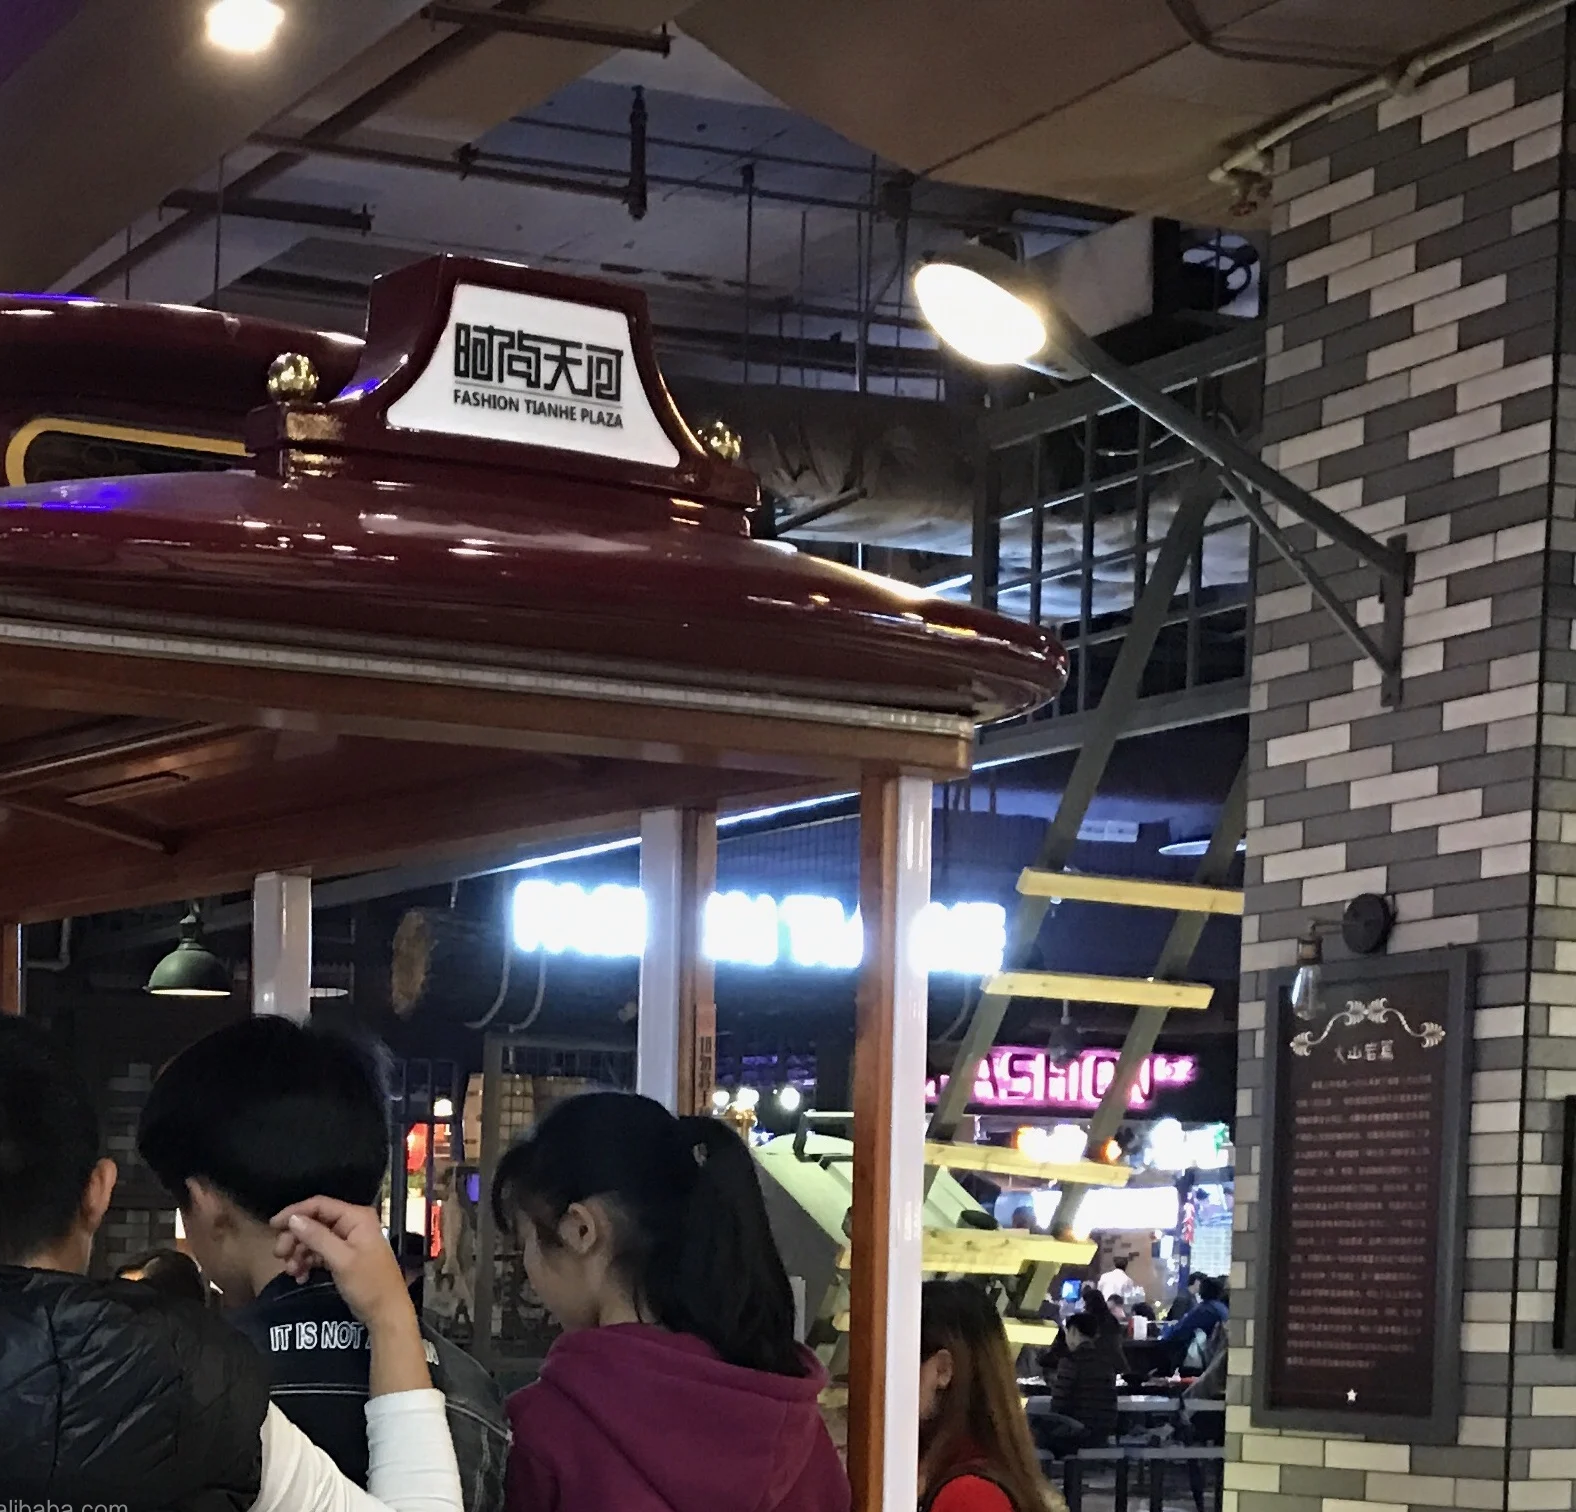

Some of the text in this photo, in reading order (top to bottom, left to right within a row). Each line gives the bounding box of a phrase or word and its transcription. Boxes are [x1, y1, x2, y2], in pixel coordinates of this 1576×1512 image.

[453, 388, 624, 429] FASHION TIANHE PLAZA
[270, 1320, 366, 1351] IT IS NOT
